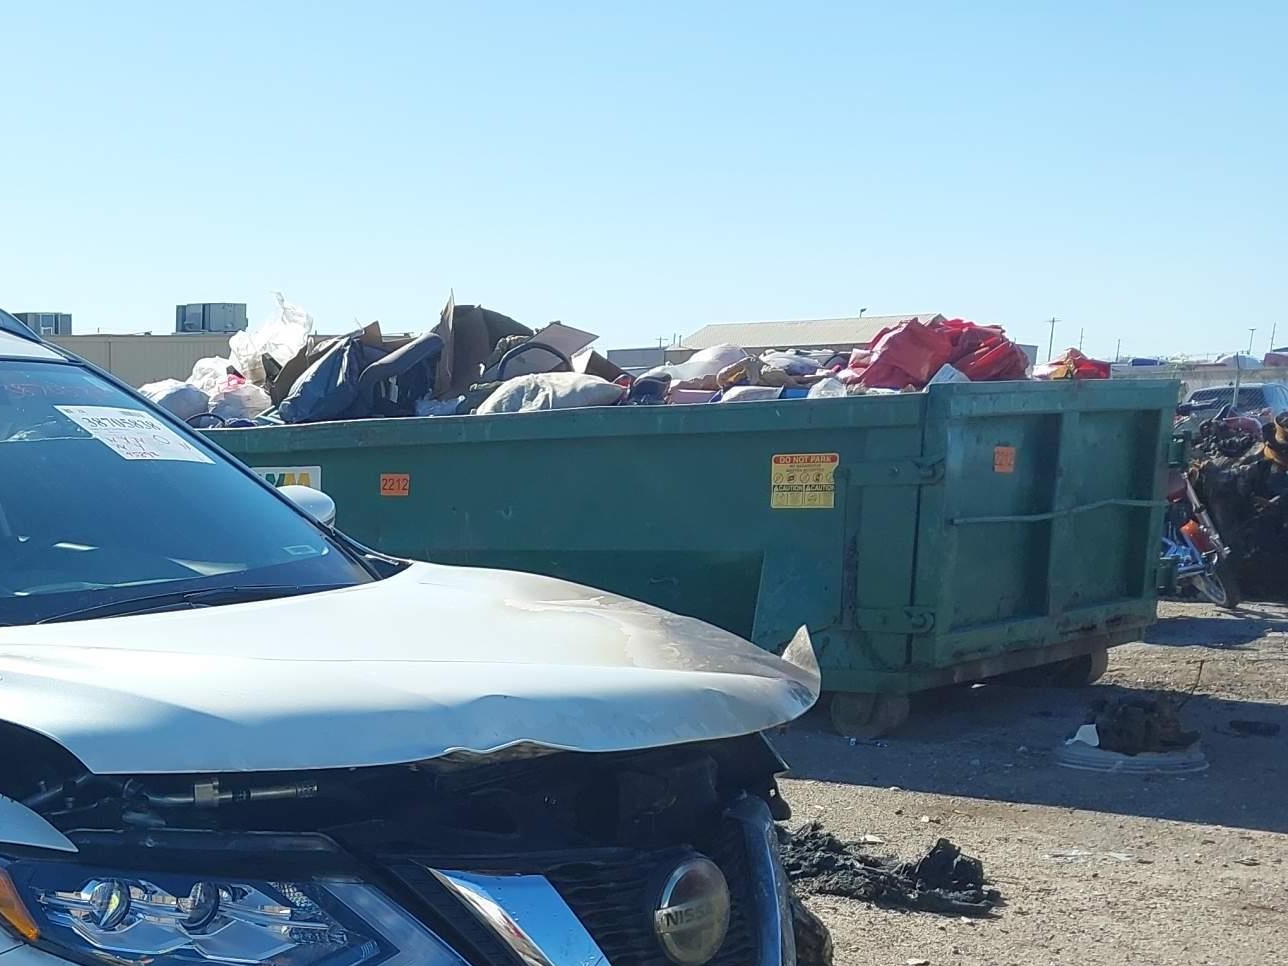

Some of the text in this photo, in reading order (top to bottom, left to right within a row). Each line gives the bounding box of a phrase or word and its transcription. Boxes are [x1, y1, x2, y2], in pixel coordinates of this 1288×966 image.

[810, 455, 832, 463] PARK
[382, 478, 408, 491] 2212
[664, 903, 714, 927] NISS
